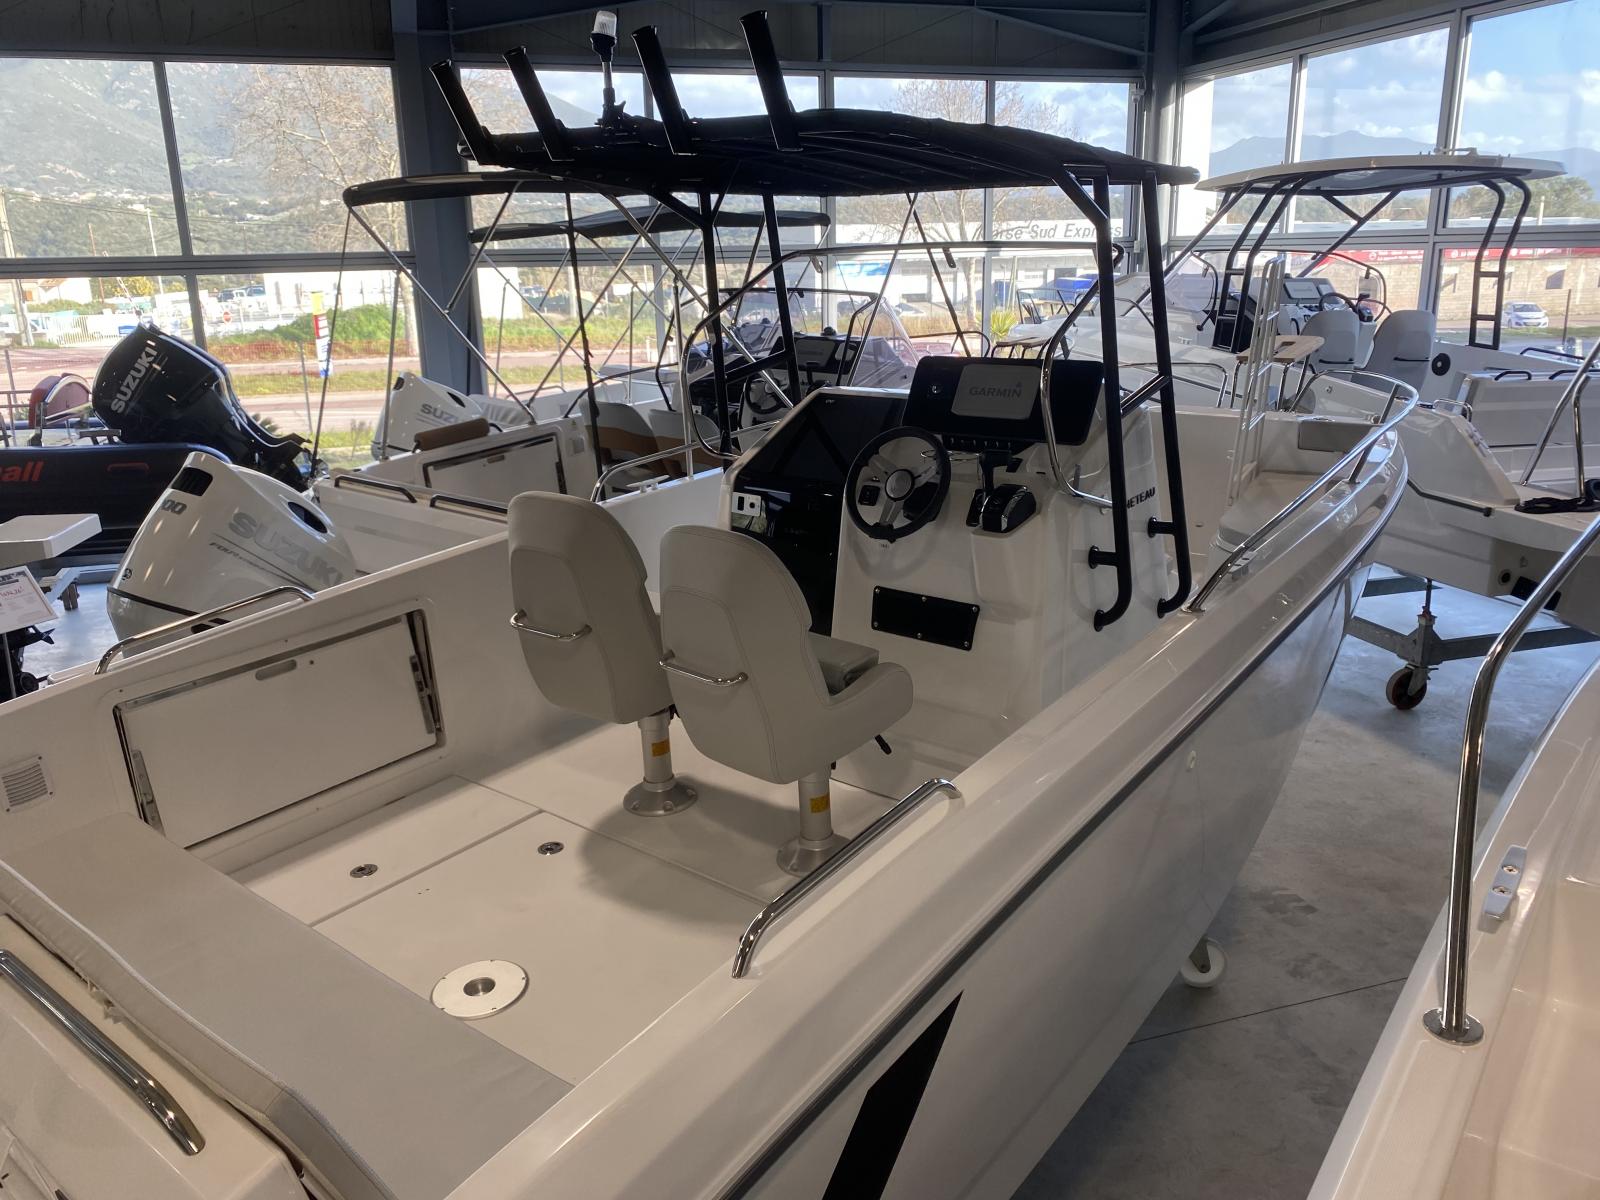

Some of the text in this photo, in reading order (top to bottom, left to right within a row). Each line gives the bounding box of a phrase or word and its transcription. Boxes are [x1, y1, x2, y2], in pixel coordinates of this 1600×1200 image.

[984, 223, 1122, 239] orse Sud Exprs
[111, 346, 158, 414] SUZUKI
[969, 386, 1022, 399] GARMIN
[420, 403, 459, 424] SUZ
[0, 461, 44, 481] all
[160, 499, 187, 515] 00
[228, 511, 344, 587] SUZUKI
